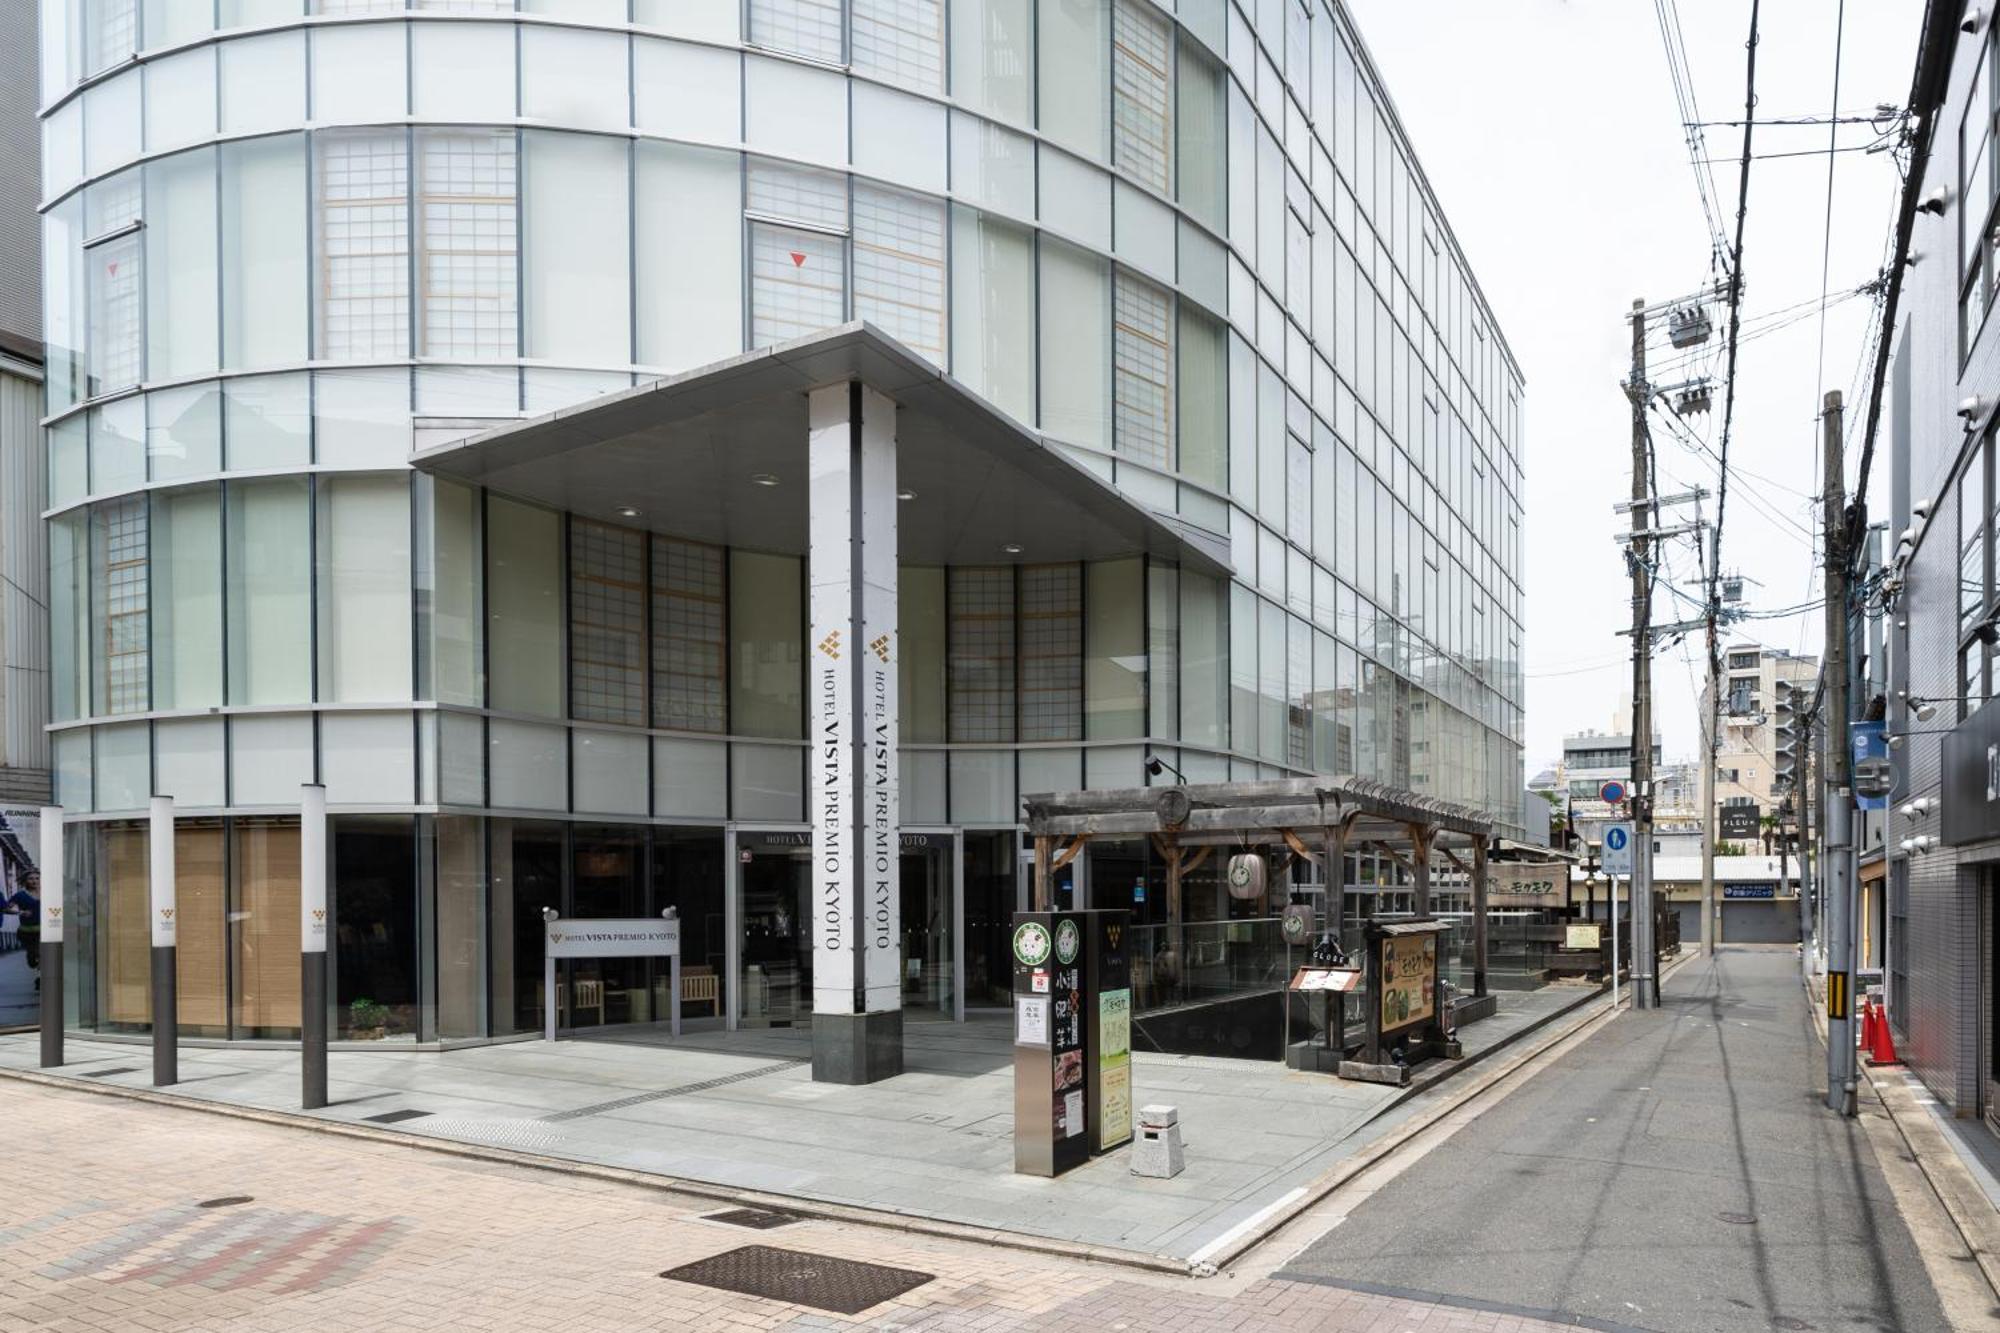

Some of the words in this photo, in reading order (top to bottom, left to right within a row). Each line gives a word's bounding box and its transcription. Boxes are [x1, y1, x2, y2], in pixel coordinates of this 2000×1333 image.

[823, 669, 836, 720] HOTEL
[875, 670, 885, 720] HOTEL
[825, 721, 839, 786] VISTA
[875, 724, 888, 786] VISTA
[825, 791, 839, 873] PREMIO
[876, 791, 889, 873] PREMIO
[899, 835, 927, 846] YOTO
[586, 933, 613, 942] VISTA
[613, 932, 646, 941] PREMIO
[648, 932, 677, 941] KYOTO
[825, 882, 841, 950] KYOTO
[876, 881, 890, 949] KYOTO
